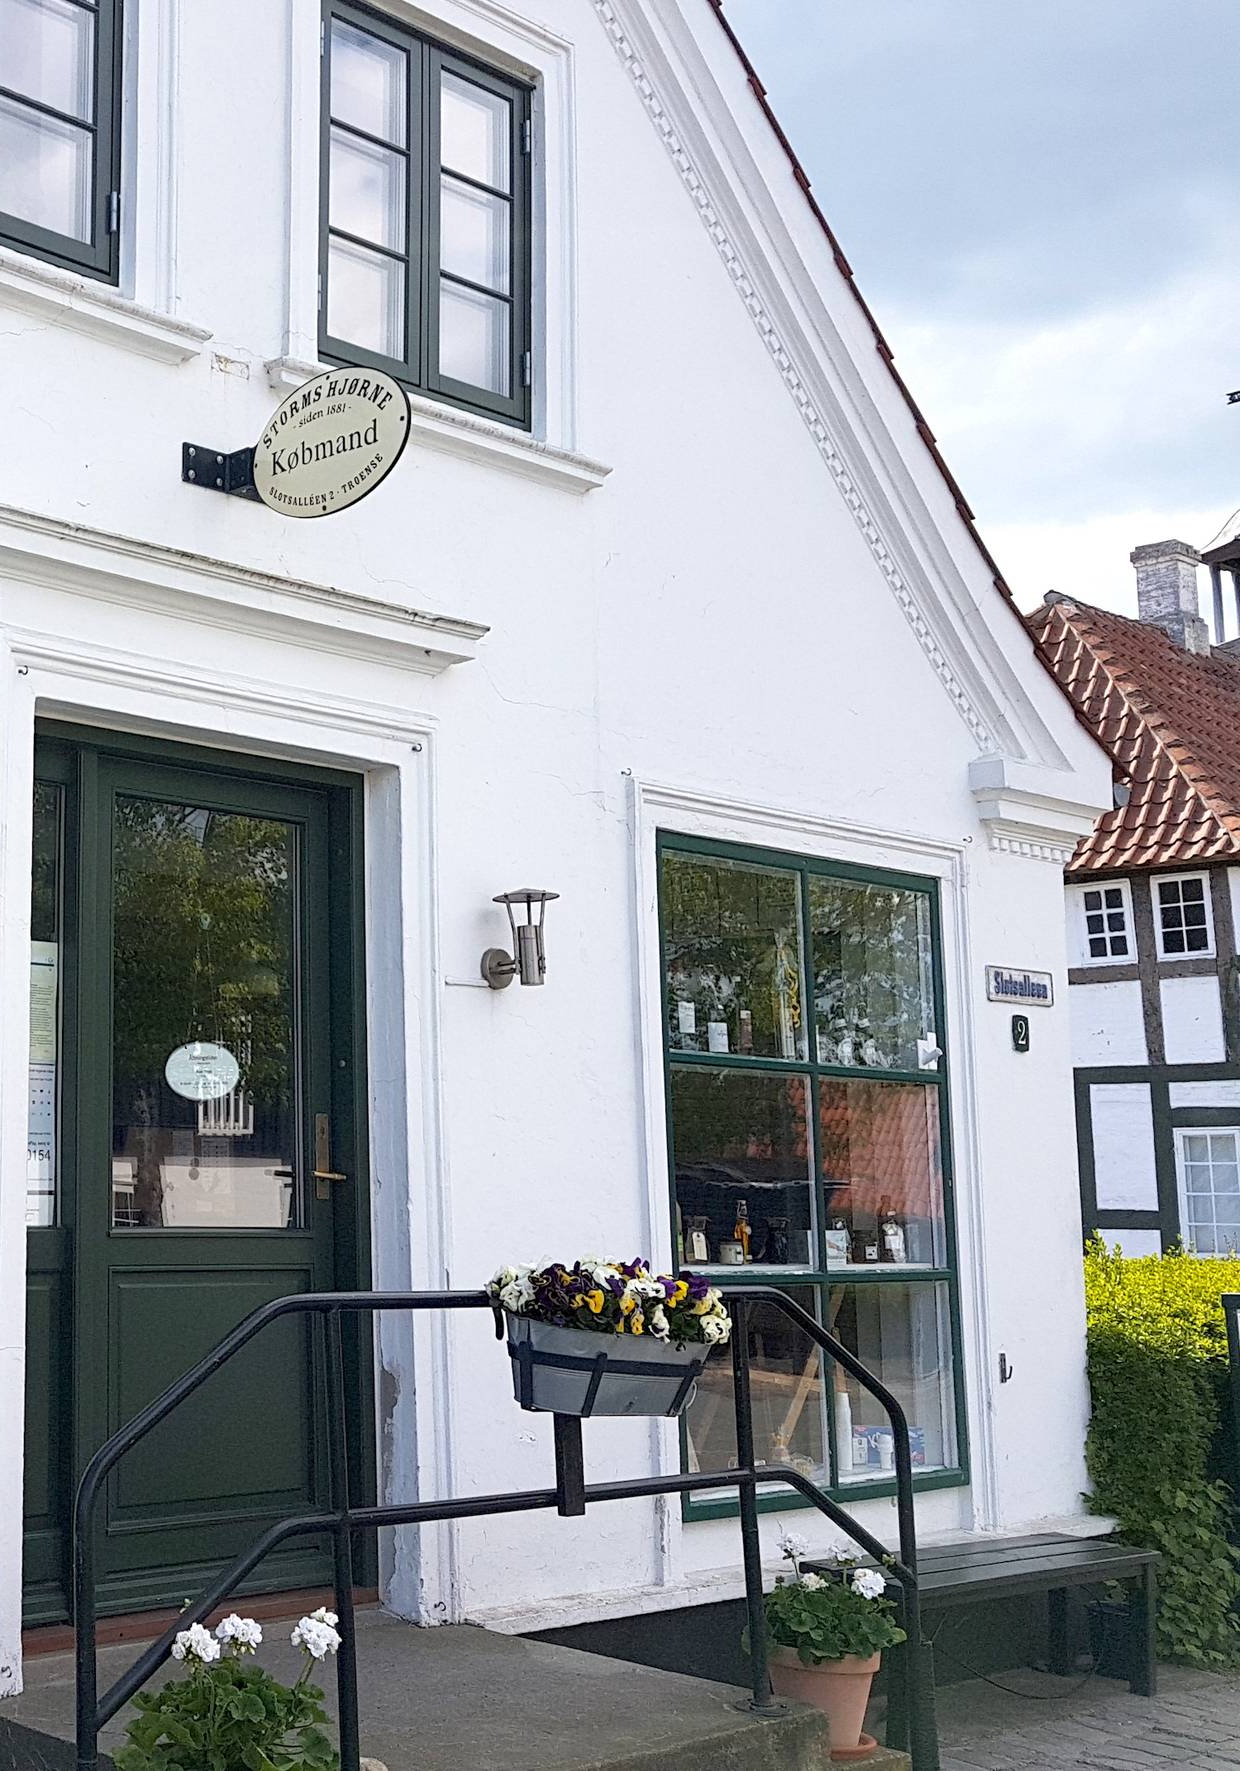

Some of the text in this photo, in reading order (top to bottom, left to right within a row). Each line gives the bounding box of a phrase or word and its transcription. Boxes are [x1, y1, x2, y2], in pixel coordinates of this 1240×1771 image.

[263, 378, 393, 449] STORMS HJØRNE
[298, 409, 324, 428] siden
[326, 402, 347, 416] 1881
[271, 418, 379, 477] Købmand
[329, 490, 335, 500] 2
[341, 453, 384, 494] TROENSE
[1017, 1020, 1027, 1045] 2
